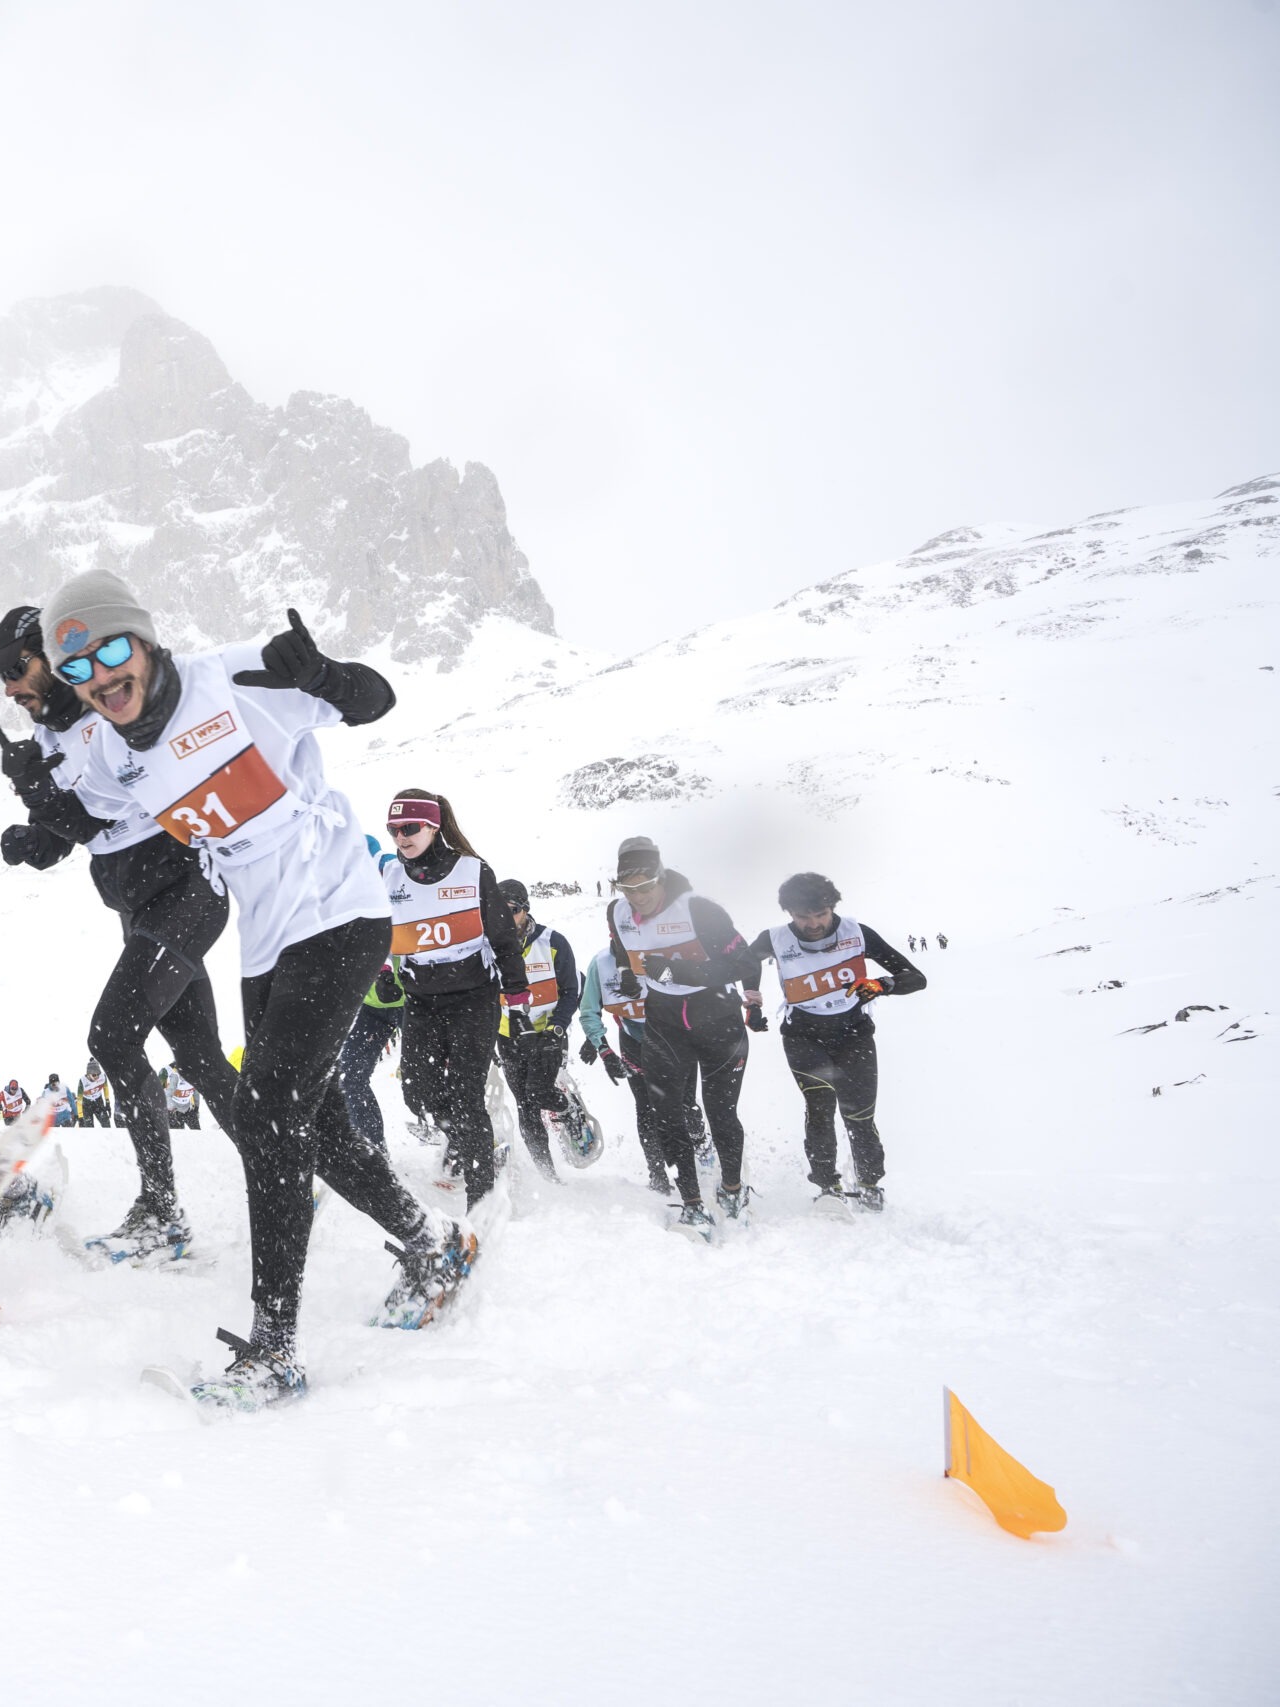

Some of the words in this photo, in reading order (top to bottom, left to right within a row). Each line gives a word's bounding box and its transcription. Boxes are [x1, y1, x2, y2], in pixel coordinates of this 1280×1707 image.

[196, 722, 221, 738] WPS
[171, 792, 238, 836] 31
[416, 922, 452, 946] 20
[803, 967, 856, 993] 119
